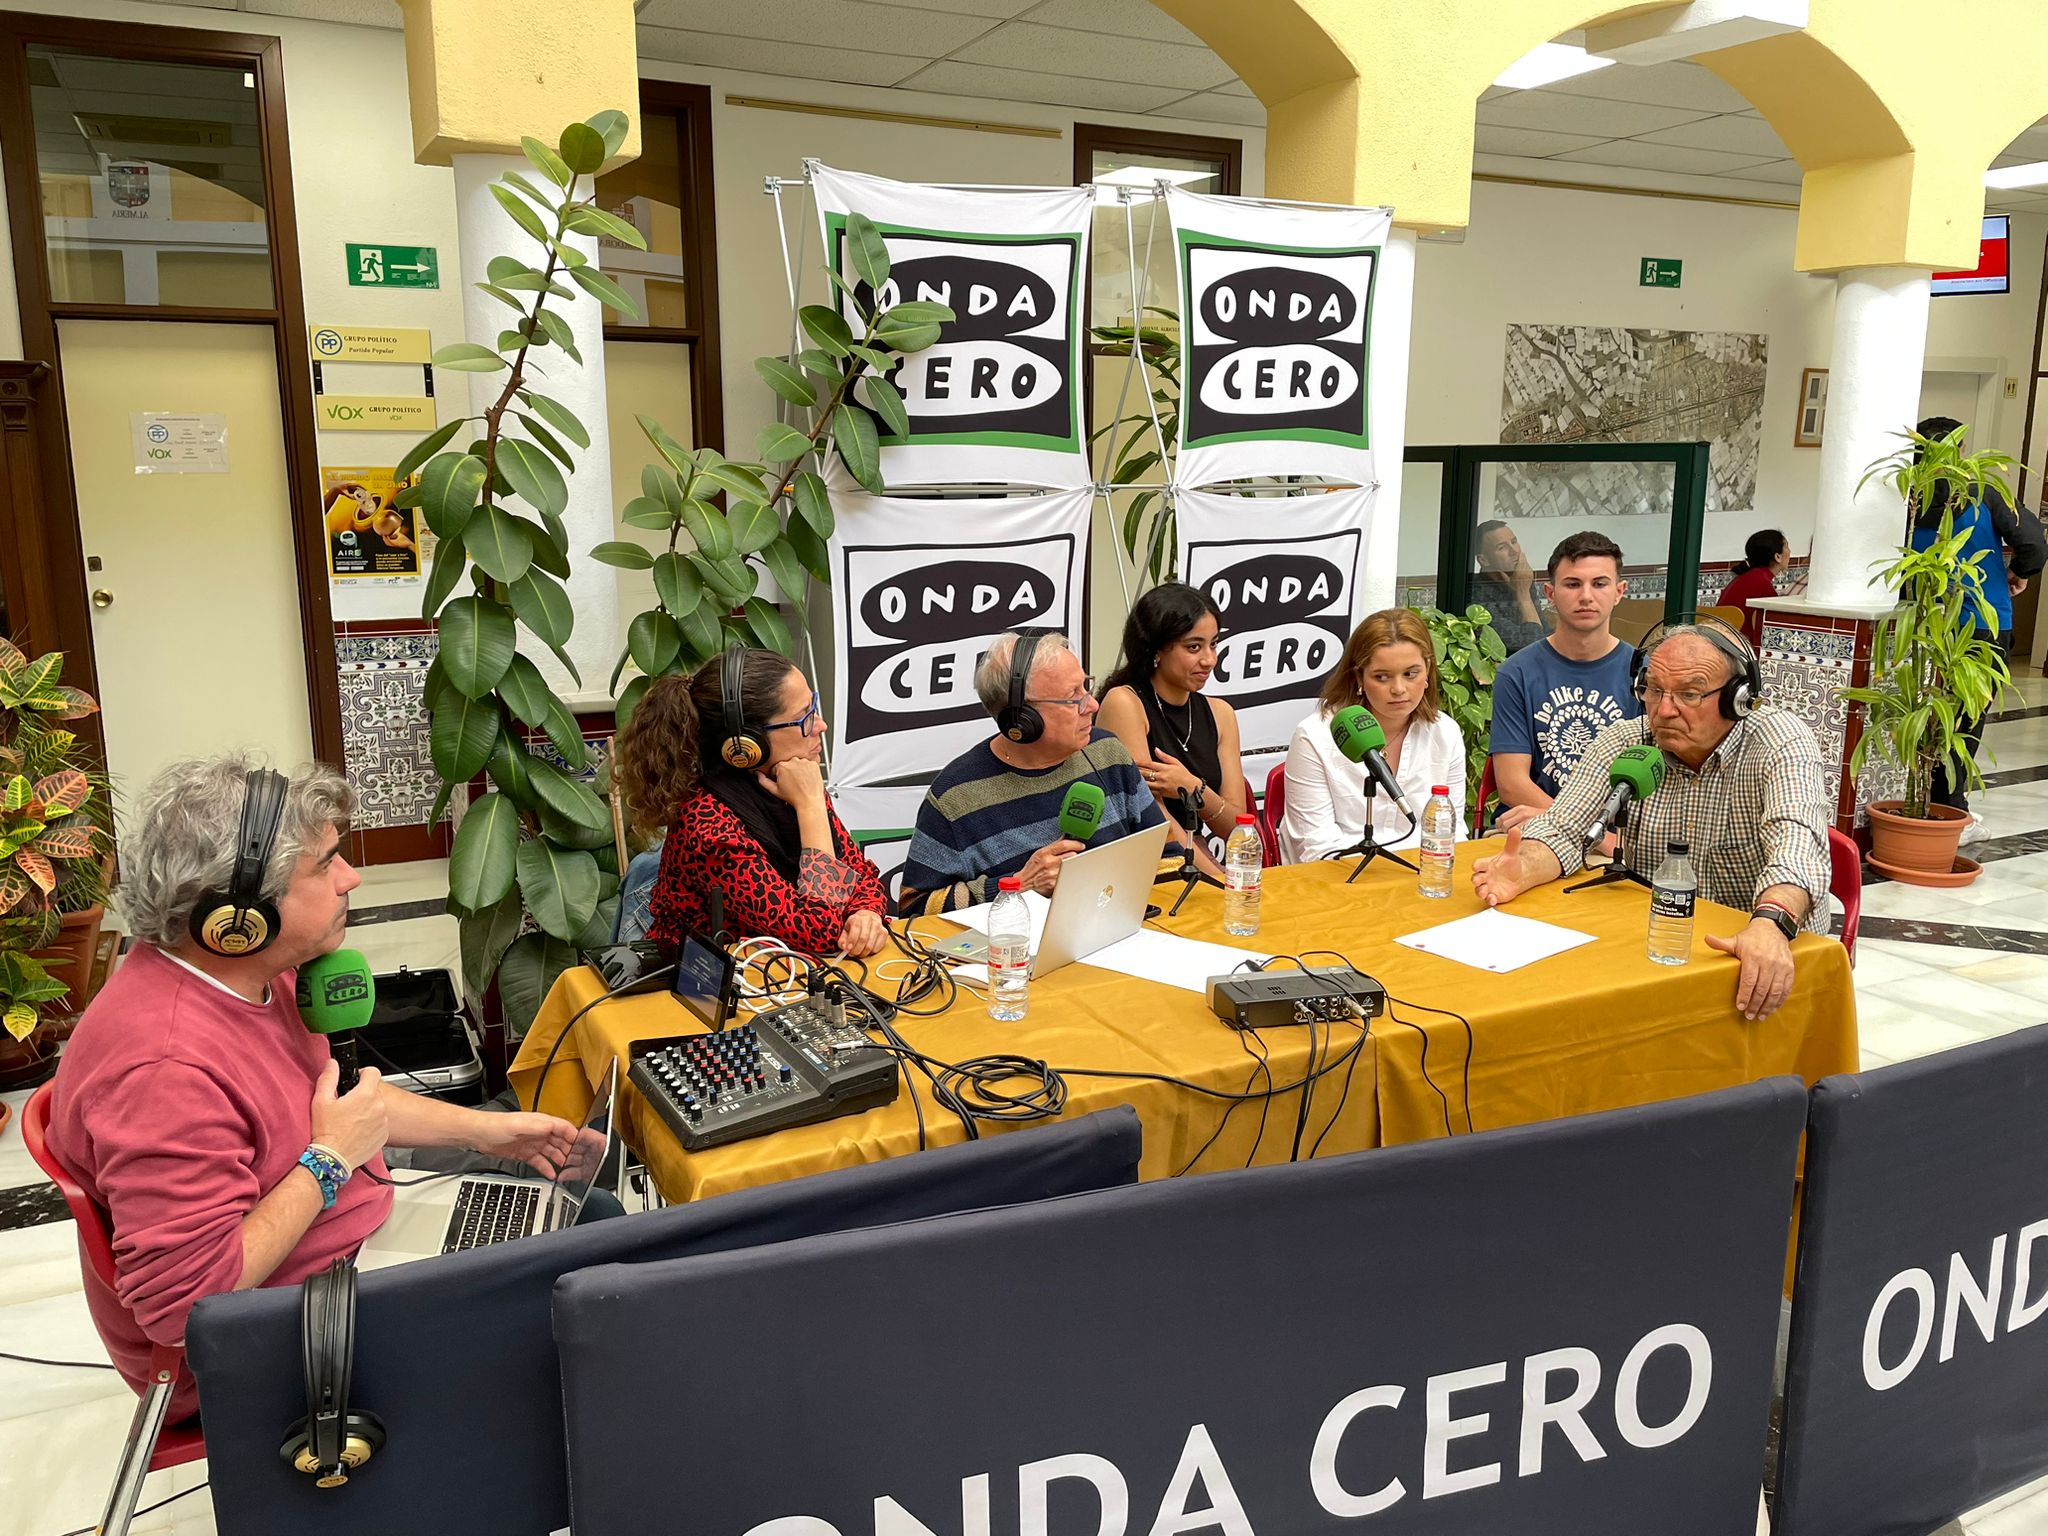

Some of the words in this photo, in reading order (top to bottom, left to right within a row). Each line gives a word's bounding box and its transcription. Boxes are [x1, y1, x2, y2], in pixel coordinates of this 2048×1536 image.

[1215, 285, 1342, 323] ONDA
[321, 338, 338, 349] PP
[1223, 359, 1340, 399] CERO
[327, 404, 364, 420] VOX
[147, 447, 172, 459] VOX
[880, 581, 1037, 622] ONDA
[1211, 572, 1329, 612] ONDA
[890, 651, 987, 699] CE
[1213, 637, 1326, 683] CERO
[1534, 701, 1554, 725] be
[1549, 686, 1584, 708] like
[1587, 689, 1600, 706] a
[1600, 695, 1625, 722] tre
[1542, 759, 1569, 788] kee
[1863, 1219, 2048, 1391] OND
[743, 1424, 1256, 1536] DA
[1310, 1323, 1712, 1518] CERO
